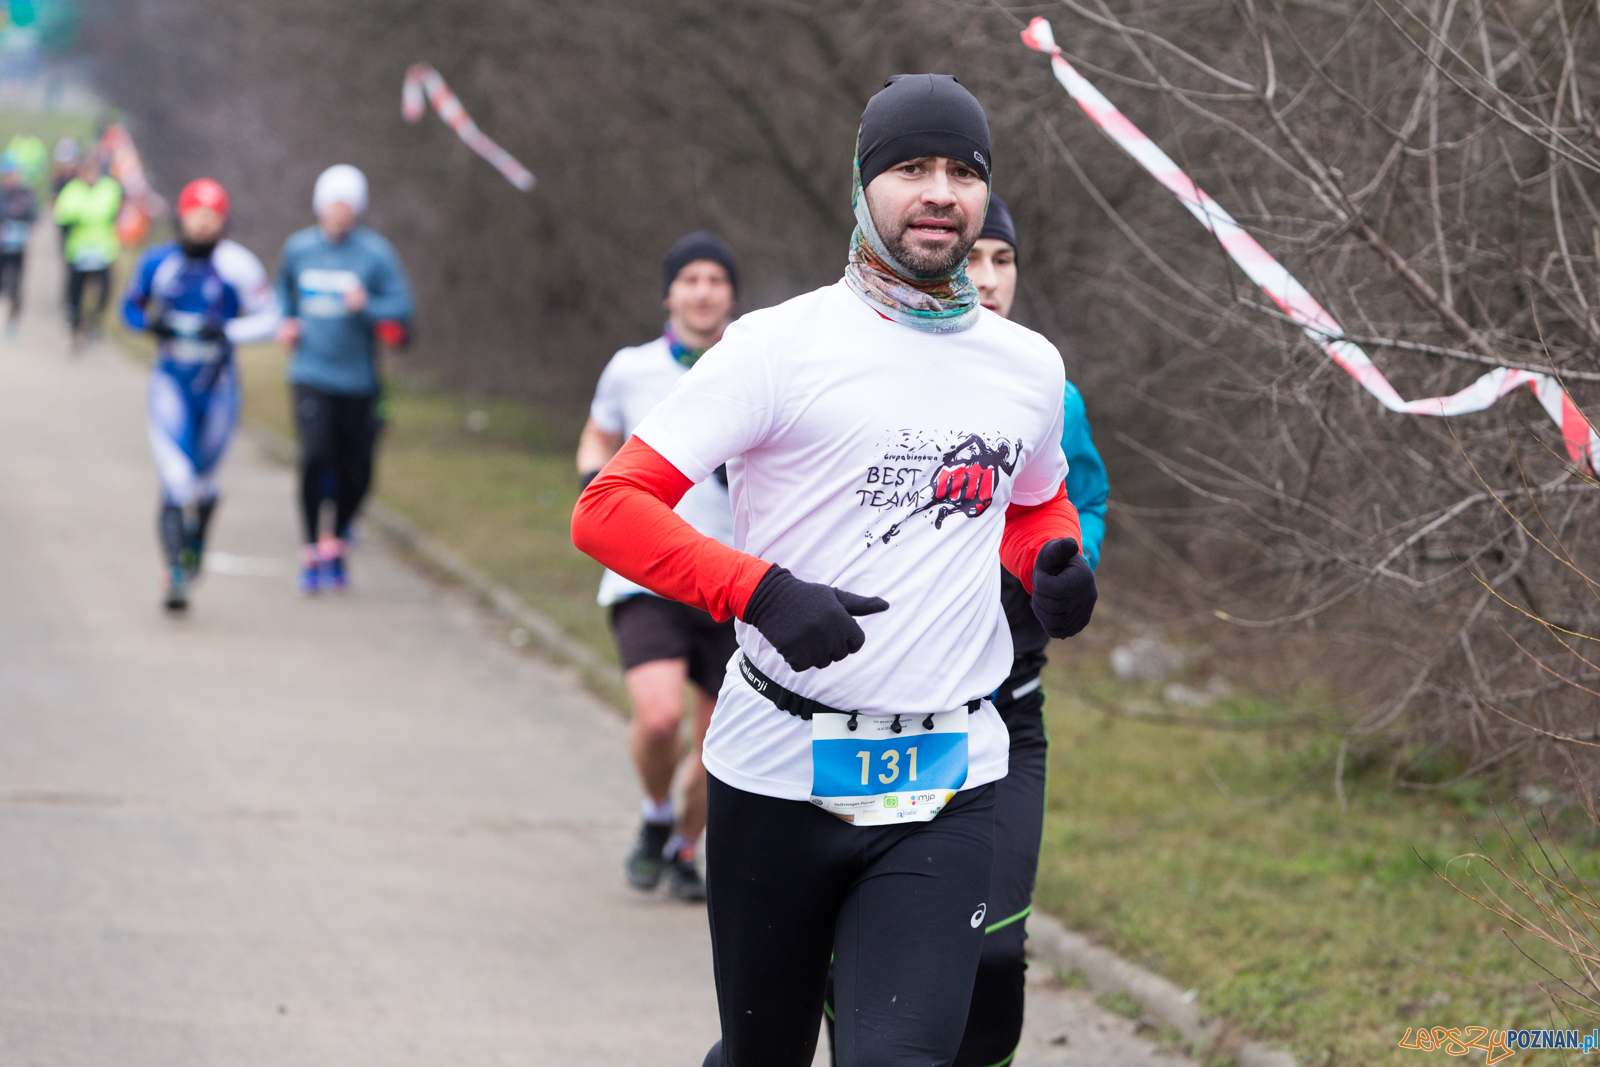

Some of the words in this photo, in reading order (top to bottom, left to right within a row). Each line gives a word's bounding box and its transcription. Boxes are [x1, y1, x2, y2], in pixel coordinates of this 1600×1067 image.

[867, 466, 922, 487] BEST
[856, 490, 920, 507] TEAM
[856, 747, 918, 786] 131
[918, 793, 936, 802] mjp
